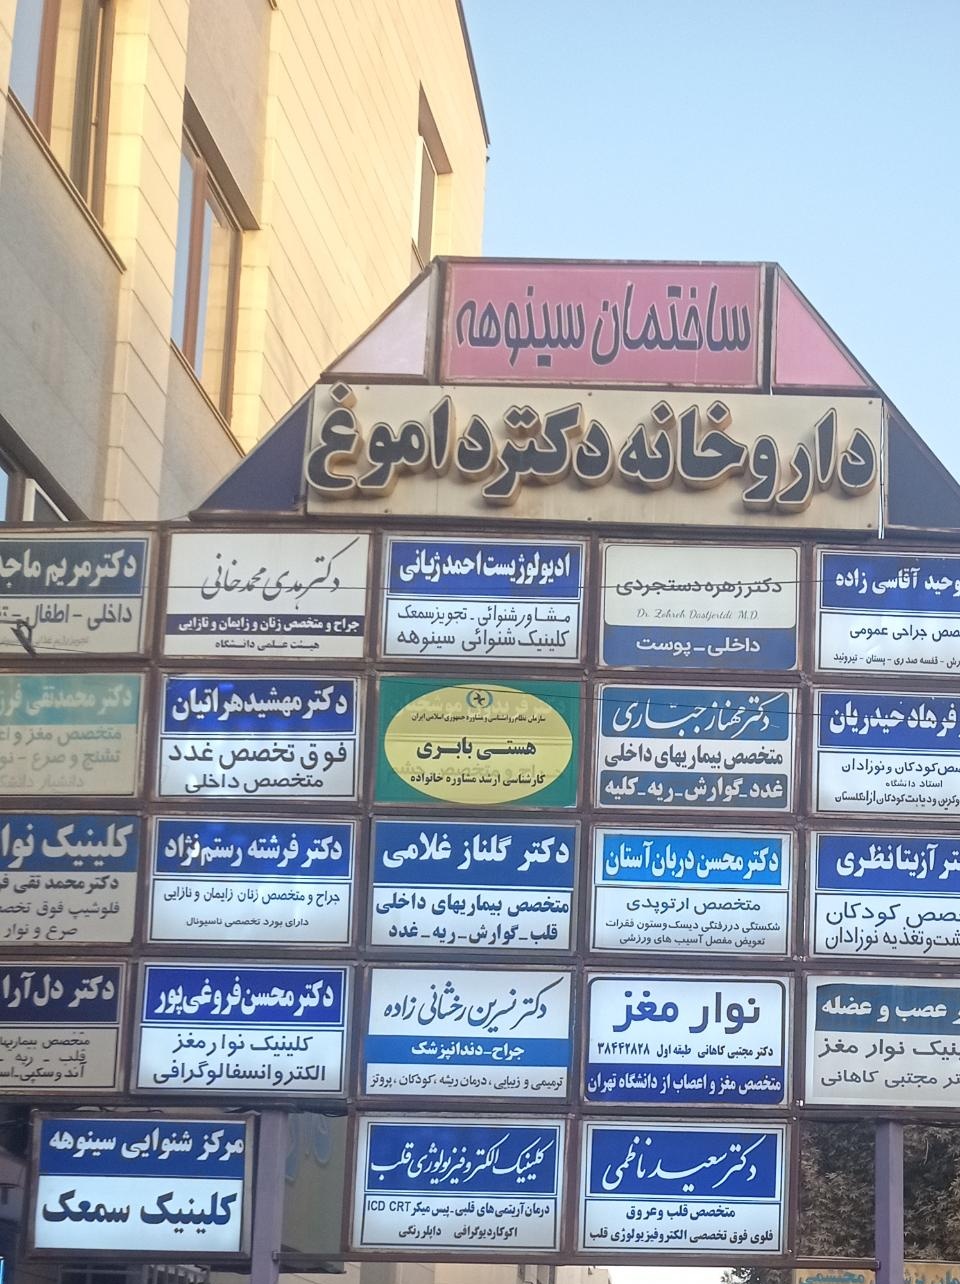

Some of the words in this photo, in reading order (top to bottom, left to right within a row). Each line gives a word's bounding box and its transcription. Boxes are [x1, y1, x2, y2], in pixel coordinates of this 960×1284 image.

[454, 286, 586, 367] سینوهه
[593, 279, 753, 367] ساختمان
[303, 379, 493, 499] داموغ
[480, 402, 614, 504] دکتر
[618, 397, 878, 513] داروخانه
[616, 579, 702, 596] دستجردی
[705, 581, 743, 598] زهره
[744, 578, 782, 598] دکتر
[26, 604, 69, 629] اطفال
[88, 604, 132, 631] داخلی
[397, 604, 435, 621] سمعک
[434, 607, 467, 626] تجویز
[478, 605, 517, 627] شنوائی
[516, 607, 571, 628] مشاور
[849, 627, 888, 639] عمومی
[893, 624, 927, 640] جراحی
[215, 639, 255, 649] دانشگاه
[257, 640, 288, 651] علمی
[636, 639, 691, 657] پوست
[707, 637, 761, 657] داخلی
[866, 655, 885, 665] پستان
[829, 701, 905, 735] حیدریان
[907, 702, 957, 737] فرهاد
[25, 727, 53, 746] مغز
[57, 727, 122, 746] متخصص
[168, 742, 214, 761] غدد
[218, 742, 295, 769] تخصص
[300, 741, 347, 772] فوق
[605, 743, 652, 768] داخلی
[655, 743, 722, 769] بیماریهای
[724, 745, 783, 769] متخصص
[841, 758, 885, 775] نوزادان
[895, 761, 938, 776] کودکان
[185, 773, 239, 793] داخلی
[243, 773, 324, 793] متخصص
[410, 772, 444, 783] خانواده
[446, 773, 477, 784] مشاوره
[478, 774, 501, 786] ارشد
[503, 774, 546, 787] کارشناسی
[886, 779, 915, 788] دانشگاه
[919, 779, 943, 788] استاد
[383, 832, 452, 868] غلامی
[457, 833, 512, 870] گلناز
[517, 836, 570, 871] دکتر
[13, 875, 41, 893] تقی
[45, 878, 85, 889] محمد
[85, 875, 119, 894] دکتر
[626, 897, 689, 914] ارتوپدی
[694, 898, 761, 915] متخصص
[826, 902, 901, 927] کودکان
[186, 918, 222, 927] ناسیونال
[225, 917, 261, 928] تخصصی
[263, 918, 282, 928] بورد
[285, 918, 309, 928] دارای
[389, 922, 418, 938] غدد
[433, 924, 455, 944] ریه
[469, 924, 519, 945] گوارش
[530, 923, 557, 944] قلب
[620, 934, 651, 945] ورزشی
[654, 935, 671, 944] های
[675, 934, 703, 945] آسیب
[705, 934, 732, 946] مفصل
[735, 937, 765, 948] تعویض
[612, 990, 679, 1033] مغز
[688, 991, 760, 1034] نوار
[821, 995, 873, 1015] عضله
[876, 1004, 889, 1023] و
[895, 1002, 947, 1022] عصب
[42, 1031, 90, 1049] متخصص
[172, 1032, 206, 1053] مغز
[206, 1033, 246, 1058] نوار
[250, 1035, 313, 1058] کلینیک
[818, 1038, 859, 1058] مغز
[656, 1044, 671, 1058] اول
[673, 1045, 691, 1058] طبقه
[697, 1045, 726, 1059] کاهانی
[727, 1046, 754, 1059] مجتبی
[755, 1046, 774, 1059] دکتر
[865, 1038, 905, 1062] نوار
[588, 1072, 617, 1093] تهران
[619, 1072, 658, 1090] دانشگاه
[660, 1073, 671, 1094] از
[672, 1073, 707, 1095] اعصاب
[709, 1081, 716, 1094] و
[718, 1076, 736, 1095] مغز
[738, 1074, 781, 1096] متخصص
[820, 1069, 879, 1087] کاهانی
[884, 1071, 938, 1088] مجتبی
[49, 1129, 117, 1158] سینوهه
[120, 1127, 193, 1159] شنوایی
[196, 1129, 244, 1162] مرکز
[42, 1189, 131, 1223] سمعک
[140, 1191, 238, 1235] کلینیک
[368, 1201, 385, 1211] ICD
[389, 1201, 410, 1212] CRT
[455, 1201, 475, 1218] قلبی
[476, 1203, 495, 1217] های
[525, 1203, 550, 1218] درمان
[589, 1227, 608, 1240] قلب
[689, 1230, 727, 1244] تخصصی
[729, 1230, 748, 1245] فوق
[751, 1230, 774, 1245] فلوی
